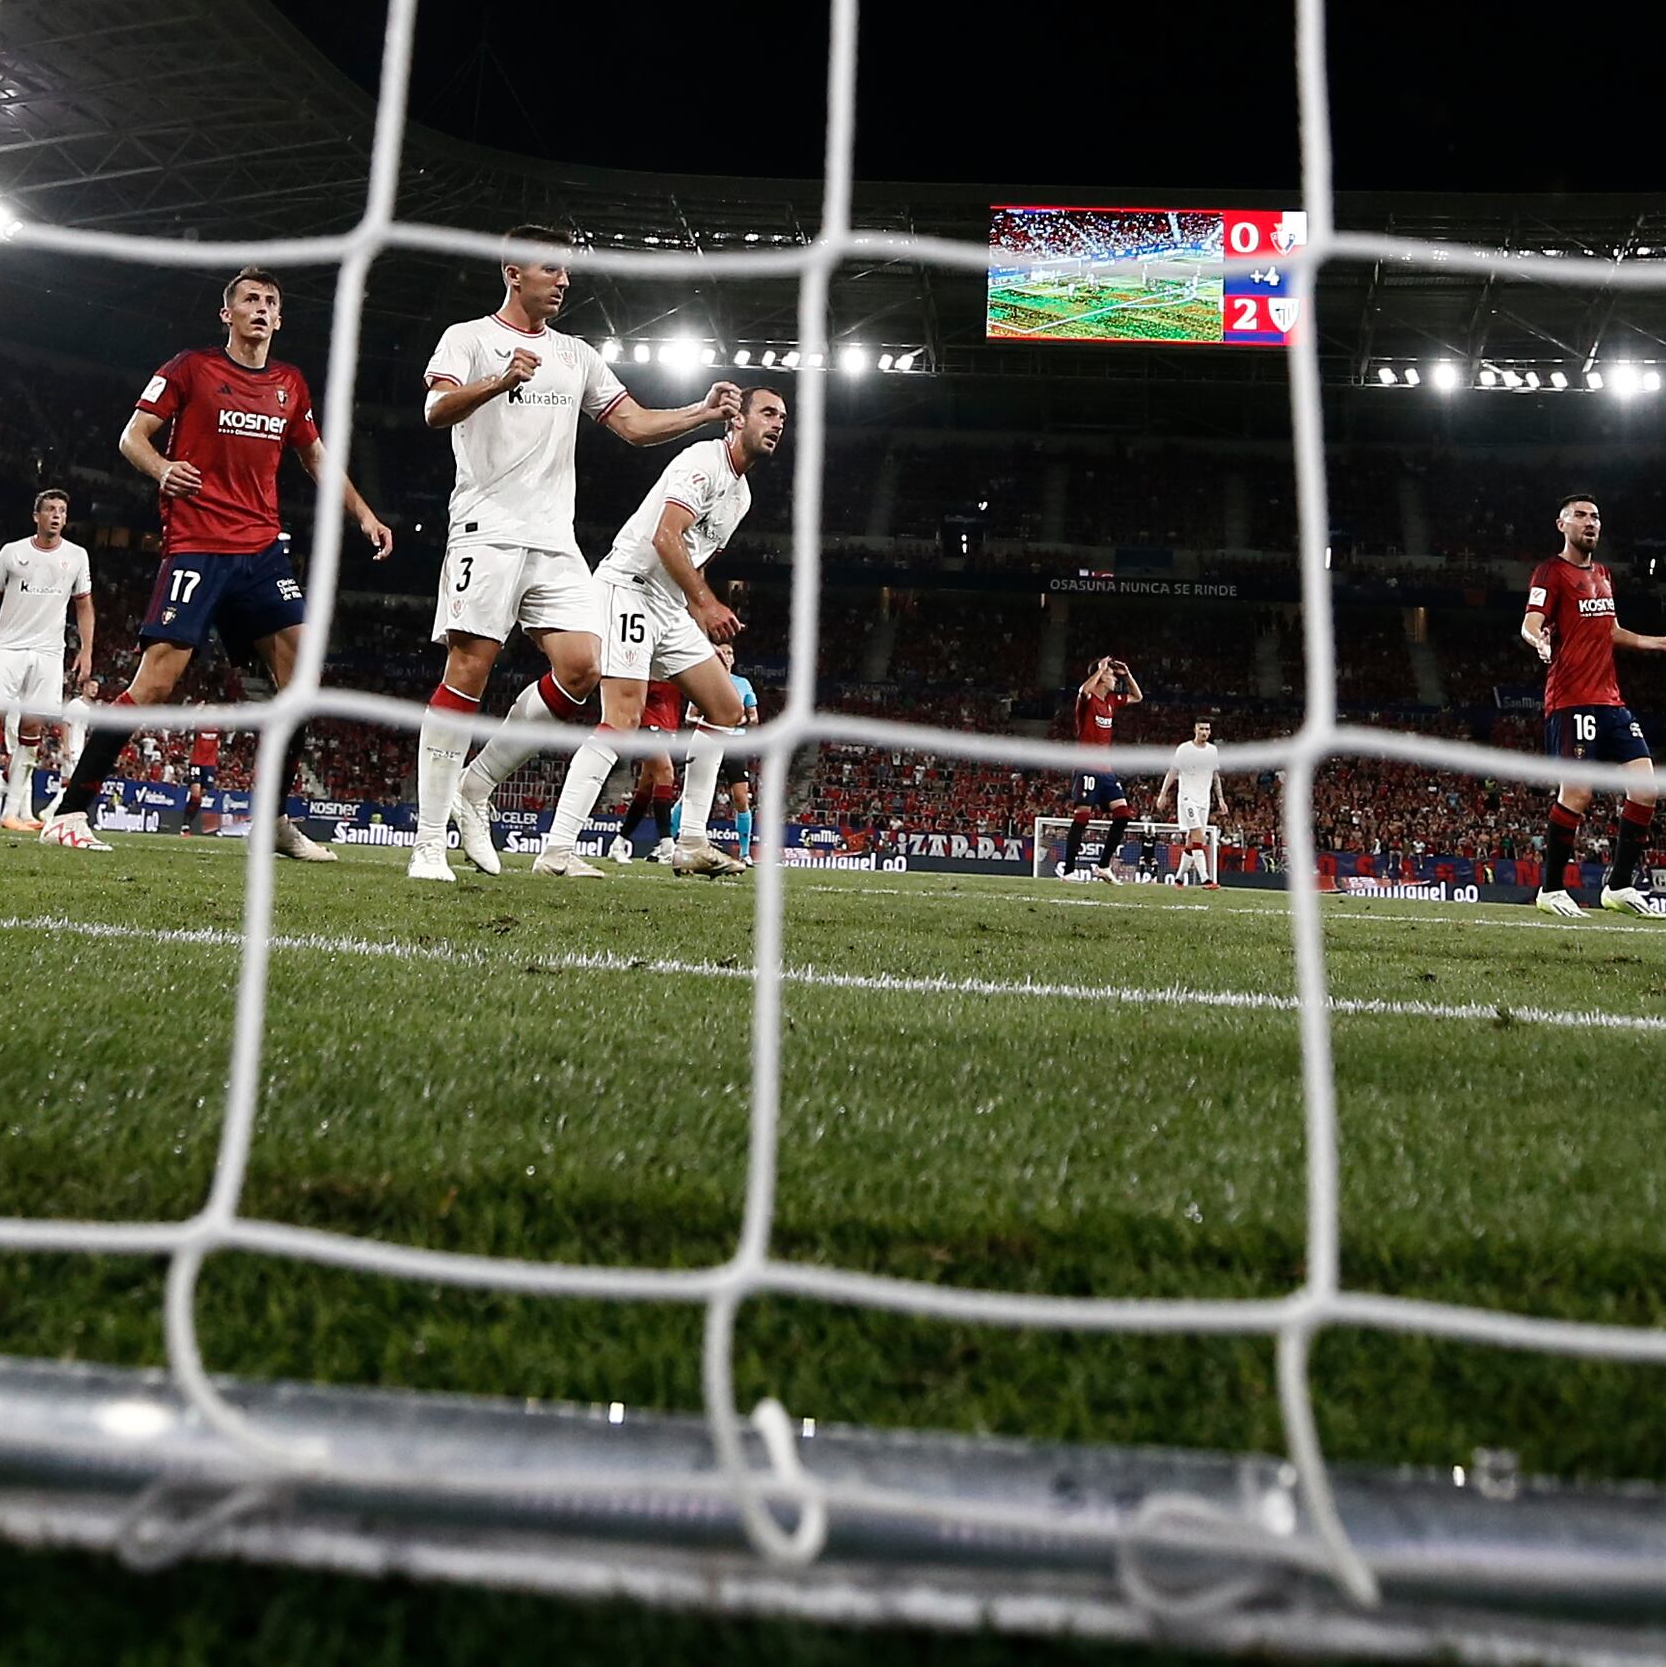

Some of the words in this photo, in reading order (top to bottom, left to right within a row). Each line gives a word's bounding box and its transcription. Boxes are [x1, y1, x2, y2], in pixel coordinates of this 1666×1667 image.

[1230, 222, 1260, 254] 0
[1232, 298, 1259, 331] 2
[169, 569, 202, 604] 17
[456, 557, 474, 592] 3
[1050, 579, 1116, 592] OSASUNA
[1120, 581, 1171, 595] NUNCA
[1174, 583, 1191, 596] SE
[1194, 584, 1238, 597] RINDE
[619, 613, 645, 643] 15
[1573, 713, 1597, 741] 16
[1083, 775, 1096, 791] 10
[502, 811, 539, 825] CELER
